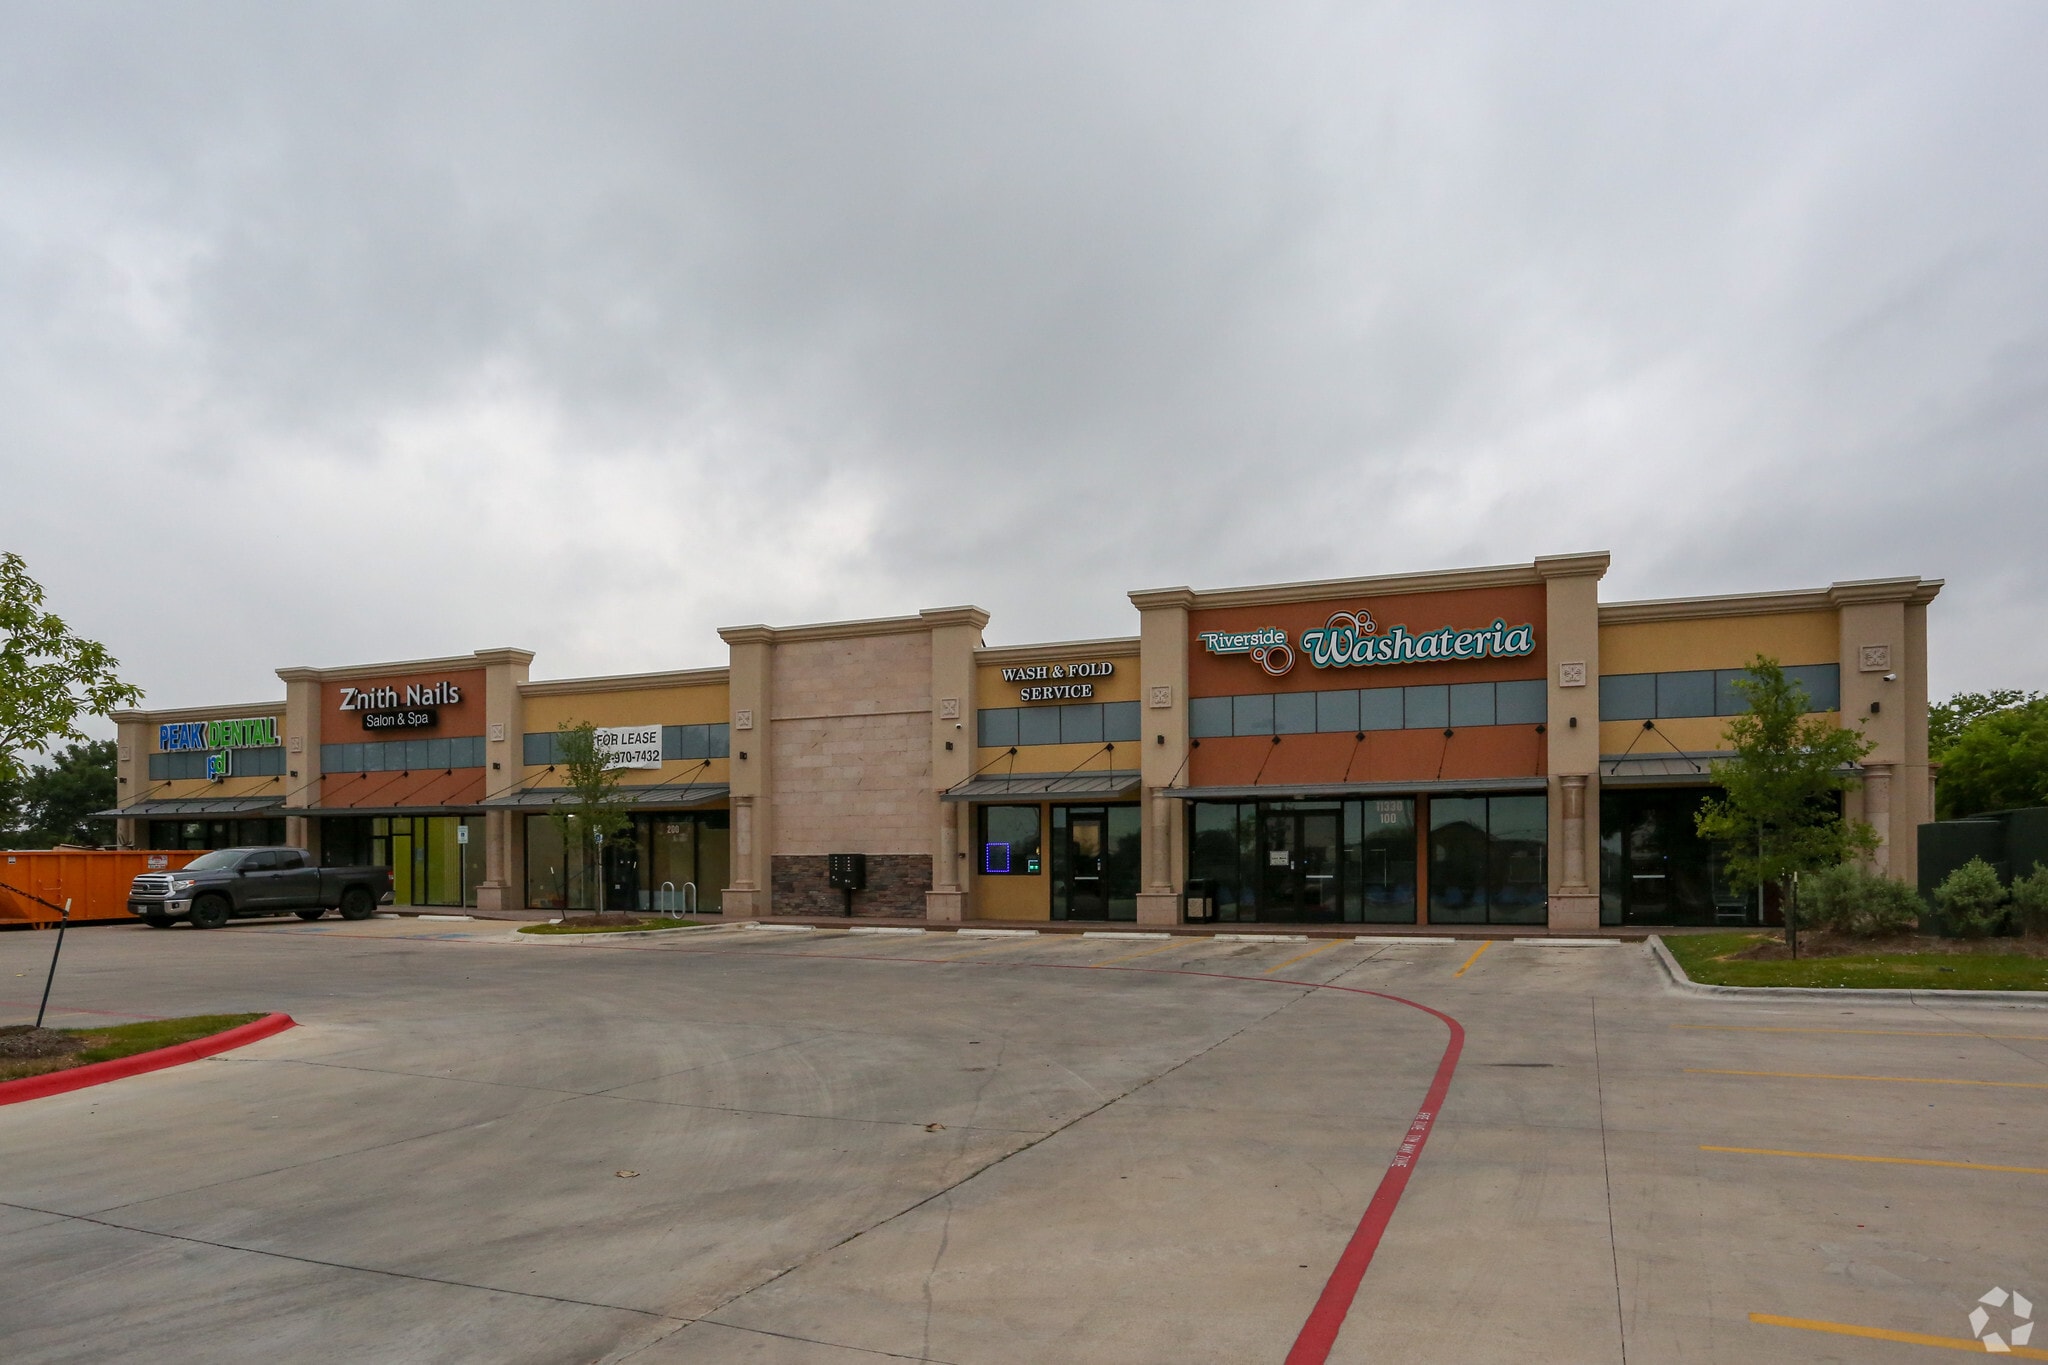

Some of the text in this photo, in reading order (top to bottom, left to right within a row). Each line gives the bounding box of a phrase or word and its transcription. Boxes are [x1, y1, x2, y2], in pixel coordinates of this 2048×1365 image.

[1202, 620, 1532, 664] Riverside Washateria
[1002, 662, 1113, 681] WASH & FOLD
[406, 681, 460, 707] Nails
[1021, 684, 1092, 701] SERVICE
[366, 711, 429, 727] Salon & Spa
[159, 717, 280, 752] PEAK DENTAL
[597, 732, 657, 746] FOR LEASE
[1376, 801, 1403, 812] 11330
[1380, 813, 1397, 824] 100
